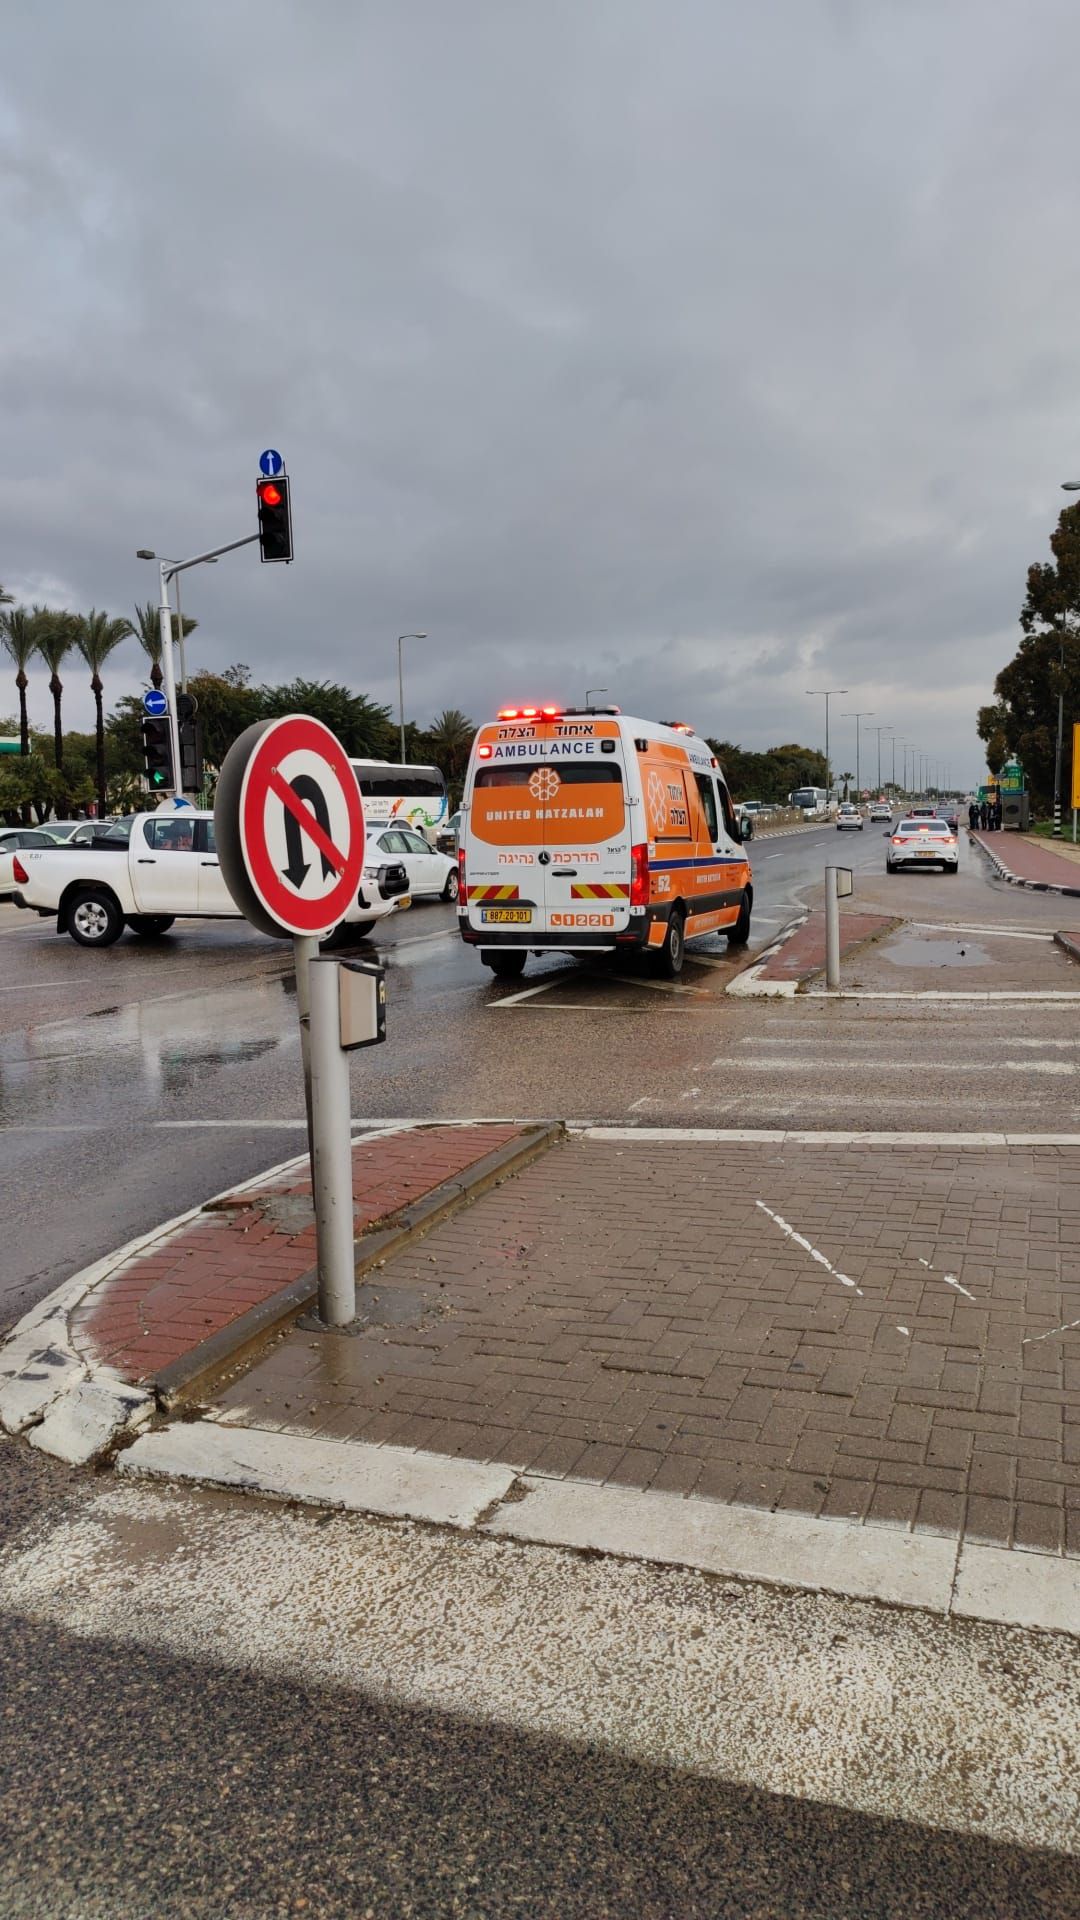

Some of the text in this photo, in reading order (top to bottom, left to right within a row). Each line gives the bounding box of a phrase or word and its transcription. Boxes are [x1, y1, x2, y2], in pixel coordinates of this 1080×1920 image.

[498, 725, 594, 739] איחוד הצלה
[494, 742, 595, 758] AMBULANCE
[486, 807, 604, 821] UNITED HATZALAH
[498, 852, 600, 865] הדרכת נהיגה
[658, 875, 671, 893] 52
[564, 914, 614, 926] 1221
